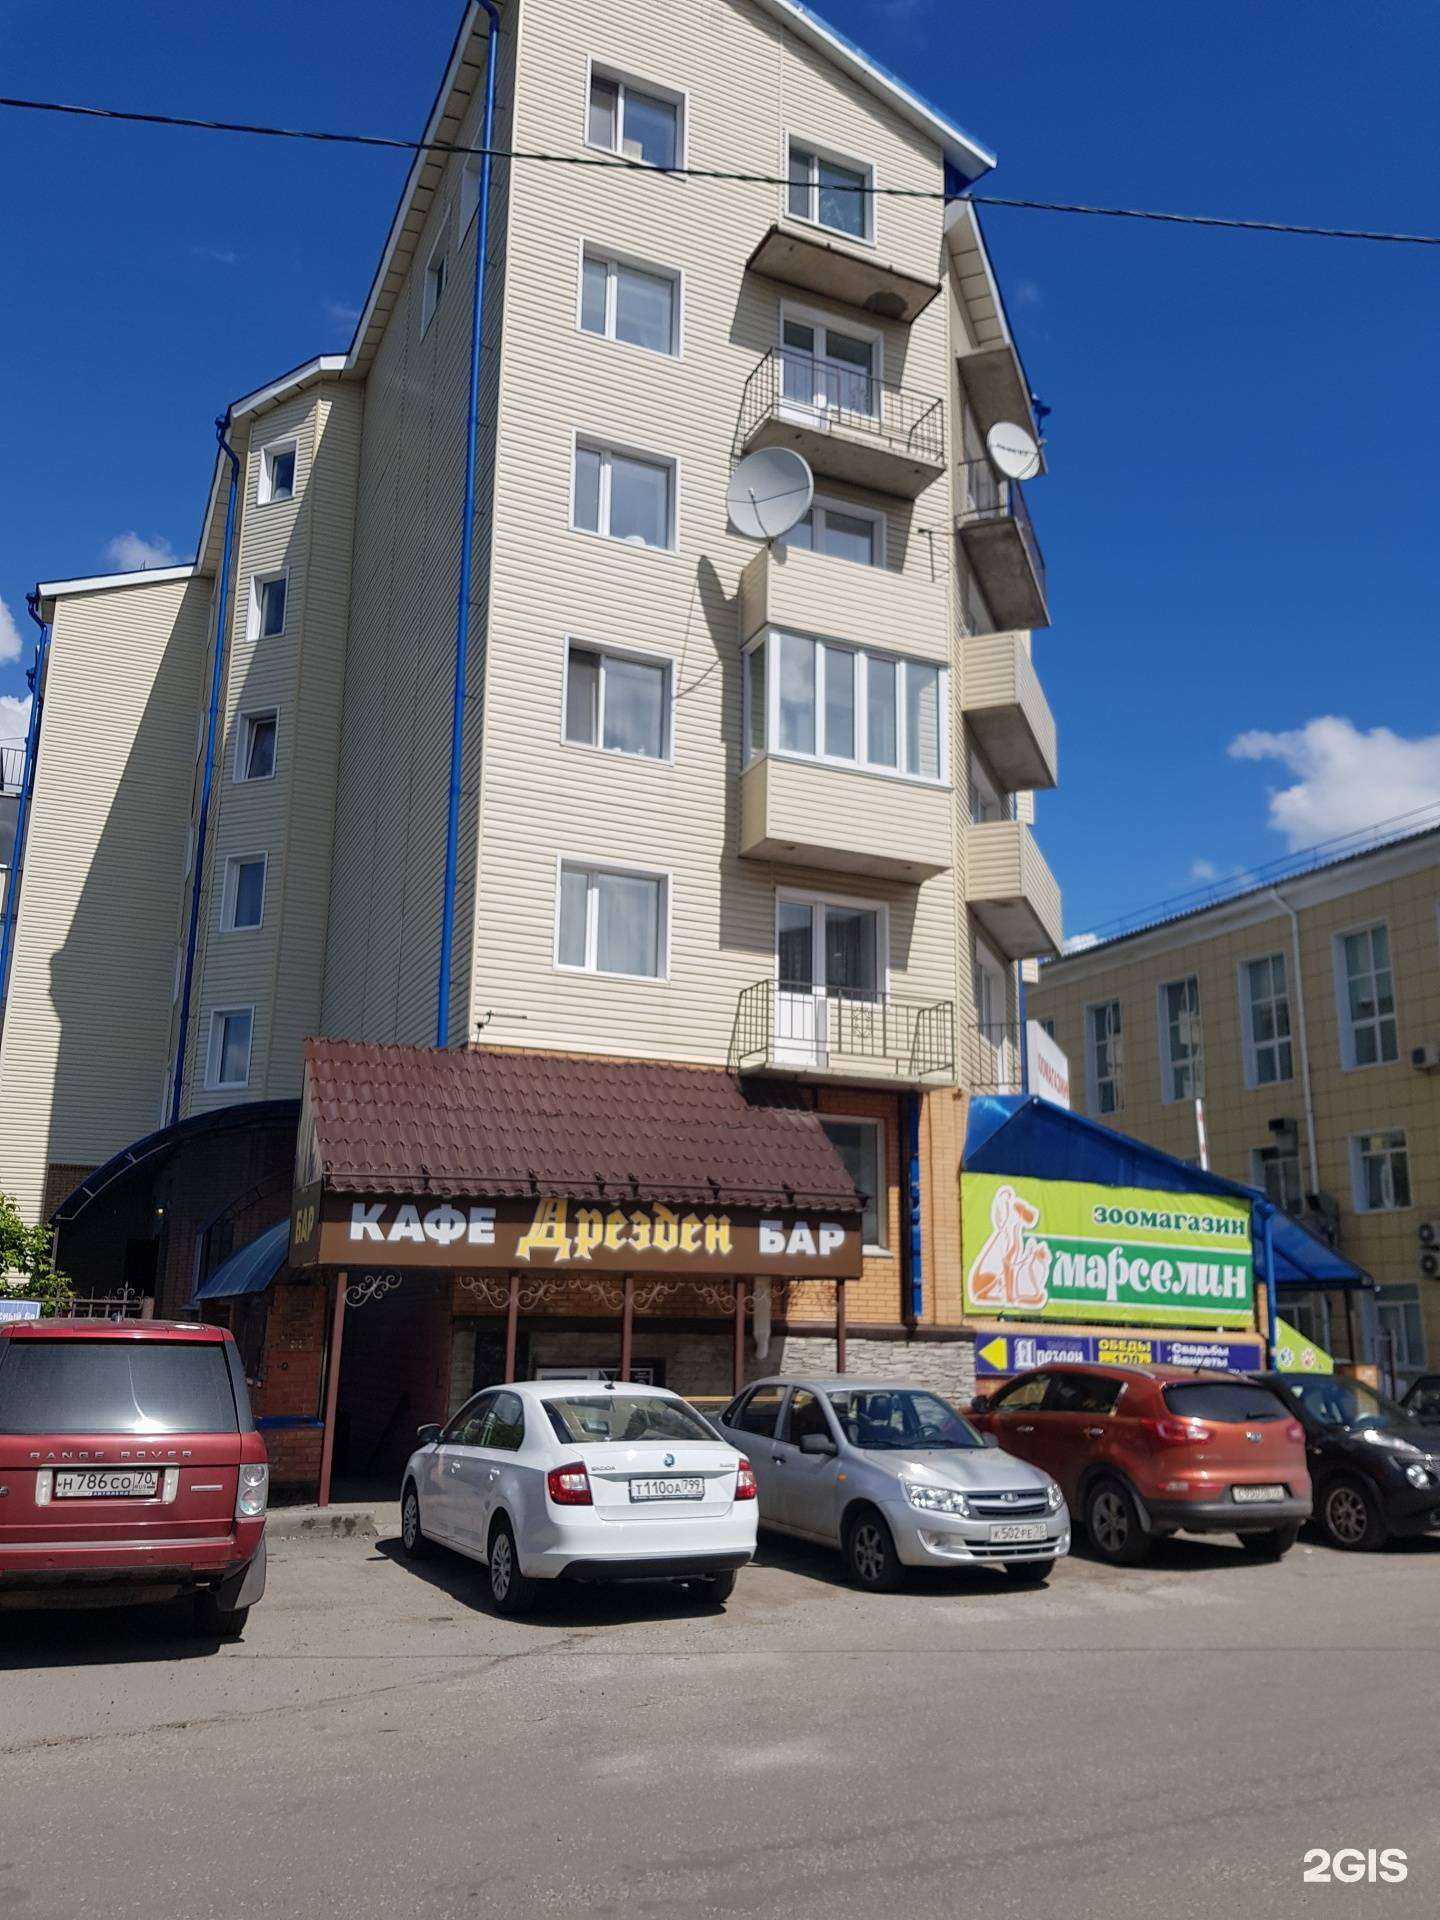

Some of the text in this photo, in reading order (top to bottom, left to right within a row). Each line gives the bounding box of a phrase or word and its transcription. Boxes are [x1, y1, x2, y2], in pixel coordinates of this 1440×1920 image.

[295, 1205, 315, 1244] БАР
[349, 1199, 846, 1262] КАФЕ Дрезден БАР
[1093, 1205, 1247, 1235] зоомагазин
[1052, 1246, 1247, 1301] марселин
[30, 1451, 105, 1459] RANGE
